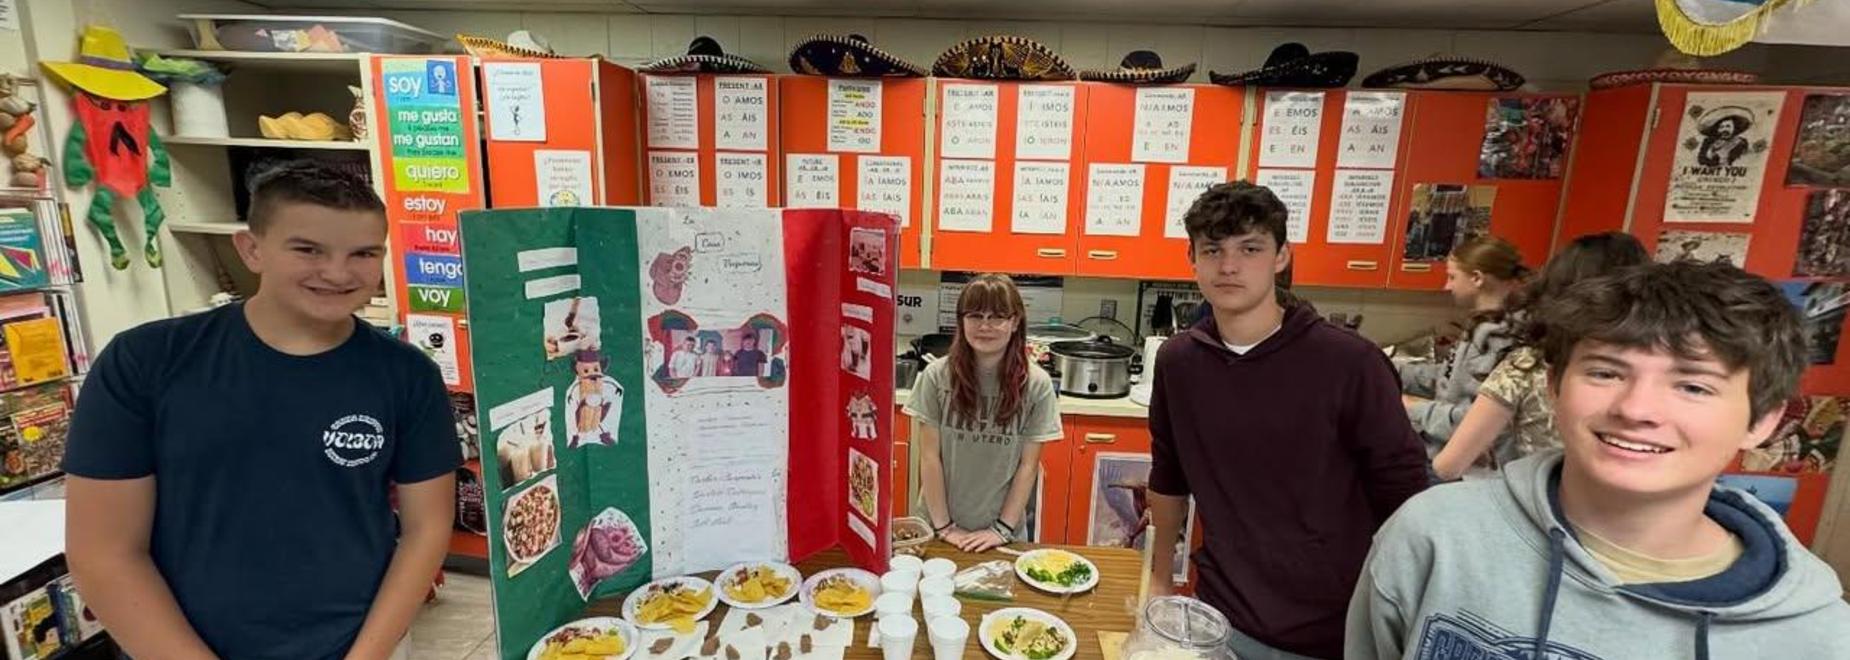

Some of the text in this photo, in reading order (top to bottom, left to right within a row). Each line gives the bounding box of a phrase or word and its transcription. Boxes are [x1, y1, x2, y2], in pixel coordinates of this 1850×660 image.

[388, 76, 421, 98] soy
[722, 95, 763, 104] O AMOS
[398, 108, 457, 124] me gusta
[1286, 108, 1318, 118] EMOS
[723, 130, 731, 139] A
[1346, 125, 1361, 134] AS
[394, 133, 459, 148] me gustan
[1269, 144, 1305, 154] E EN
[1346, 143, 1385, 153] A AN
[405, 164, 459, 183] quiero
[1682, 166, 1747, 178] I WANT YOU
[404, 197, 445, 215] estoy
[425, 226, 457, 246] hay
[418, 288, 450, 307] voy
[896, 295, 922, 308] SUR
